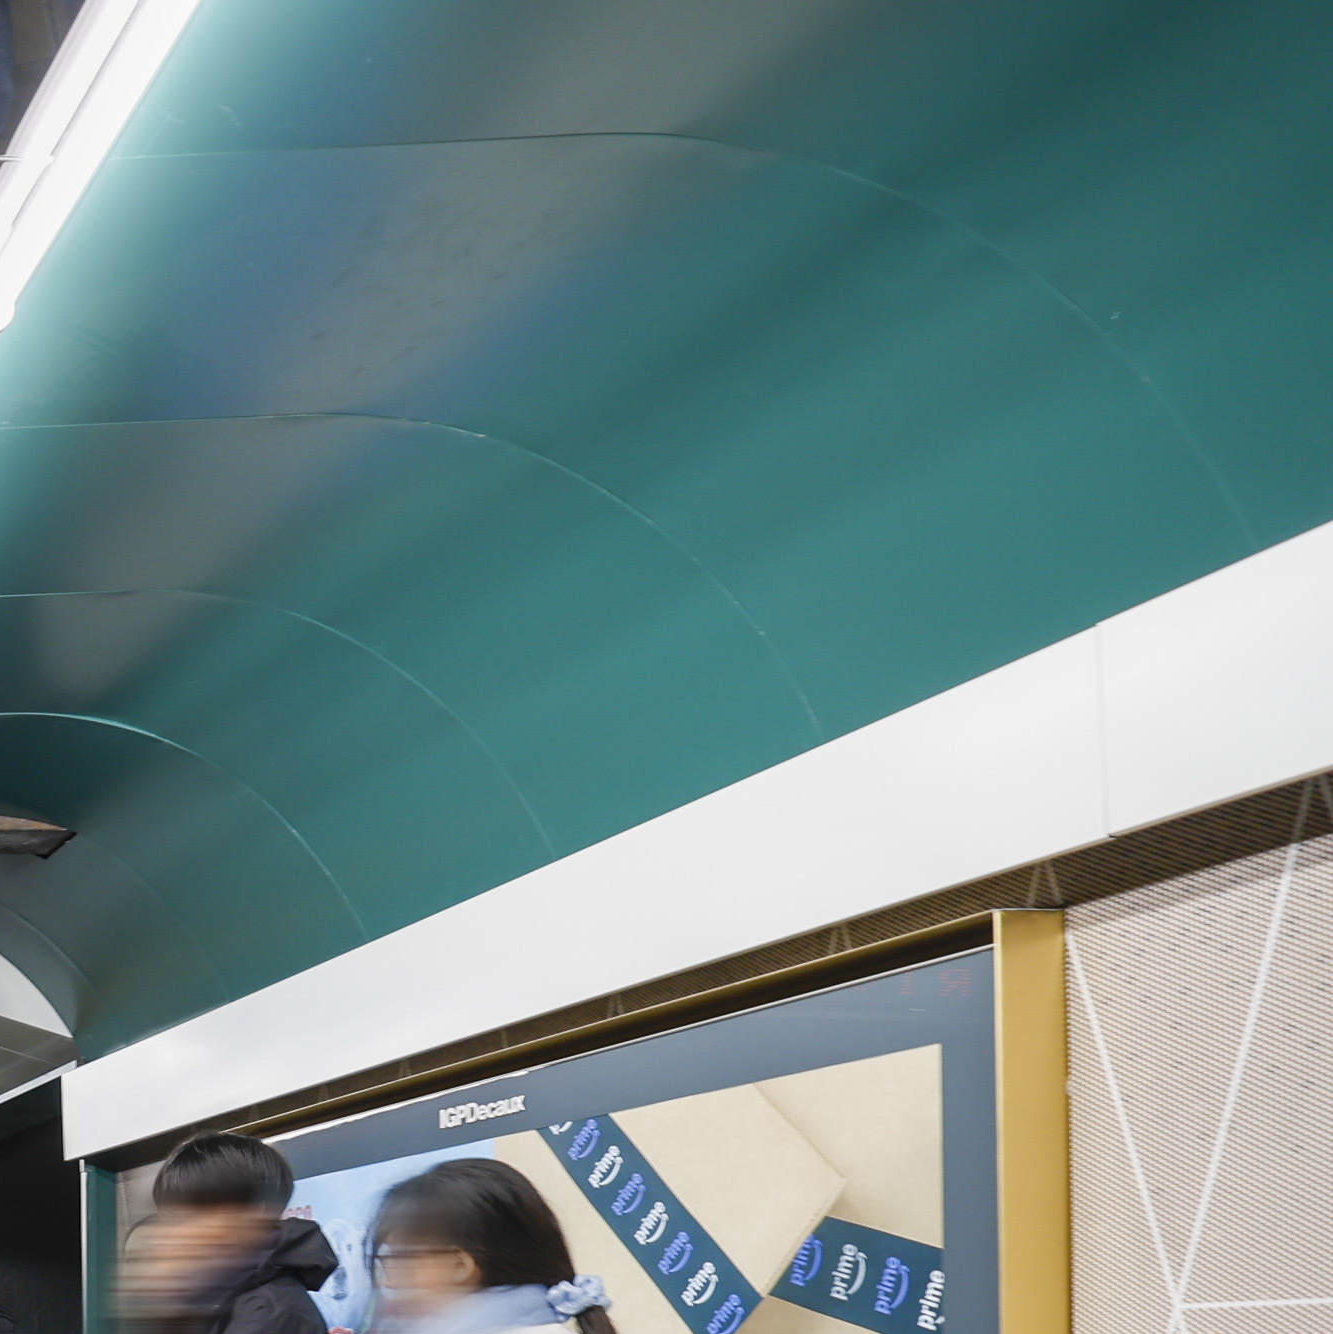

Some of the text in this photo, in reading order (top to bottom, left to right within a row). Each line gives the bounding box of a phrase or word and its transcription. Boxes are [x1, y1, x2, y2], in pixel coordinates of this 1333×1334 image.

[438, 1095, 526, 1129] IGPDecaux
[829, 1243, 859, 1301] prime
[874, 1256, 902, 1315] prime
[917, 1269, 945, 1331] prime
